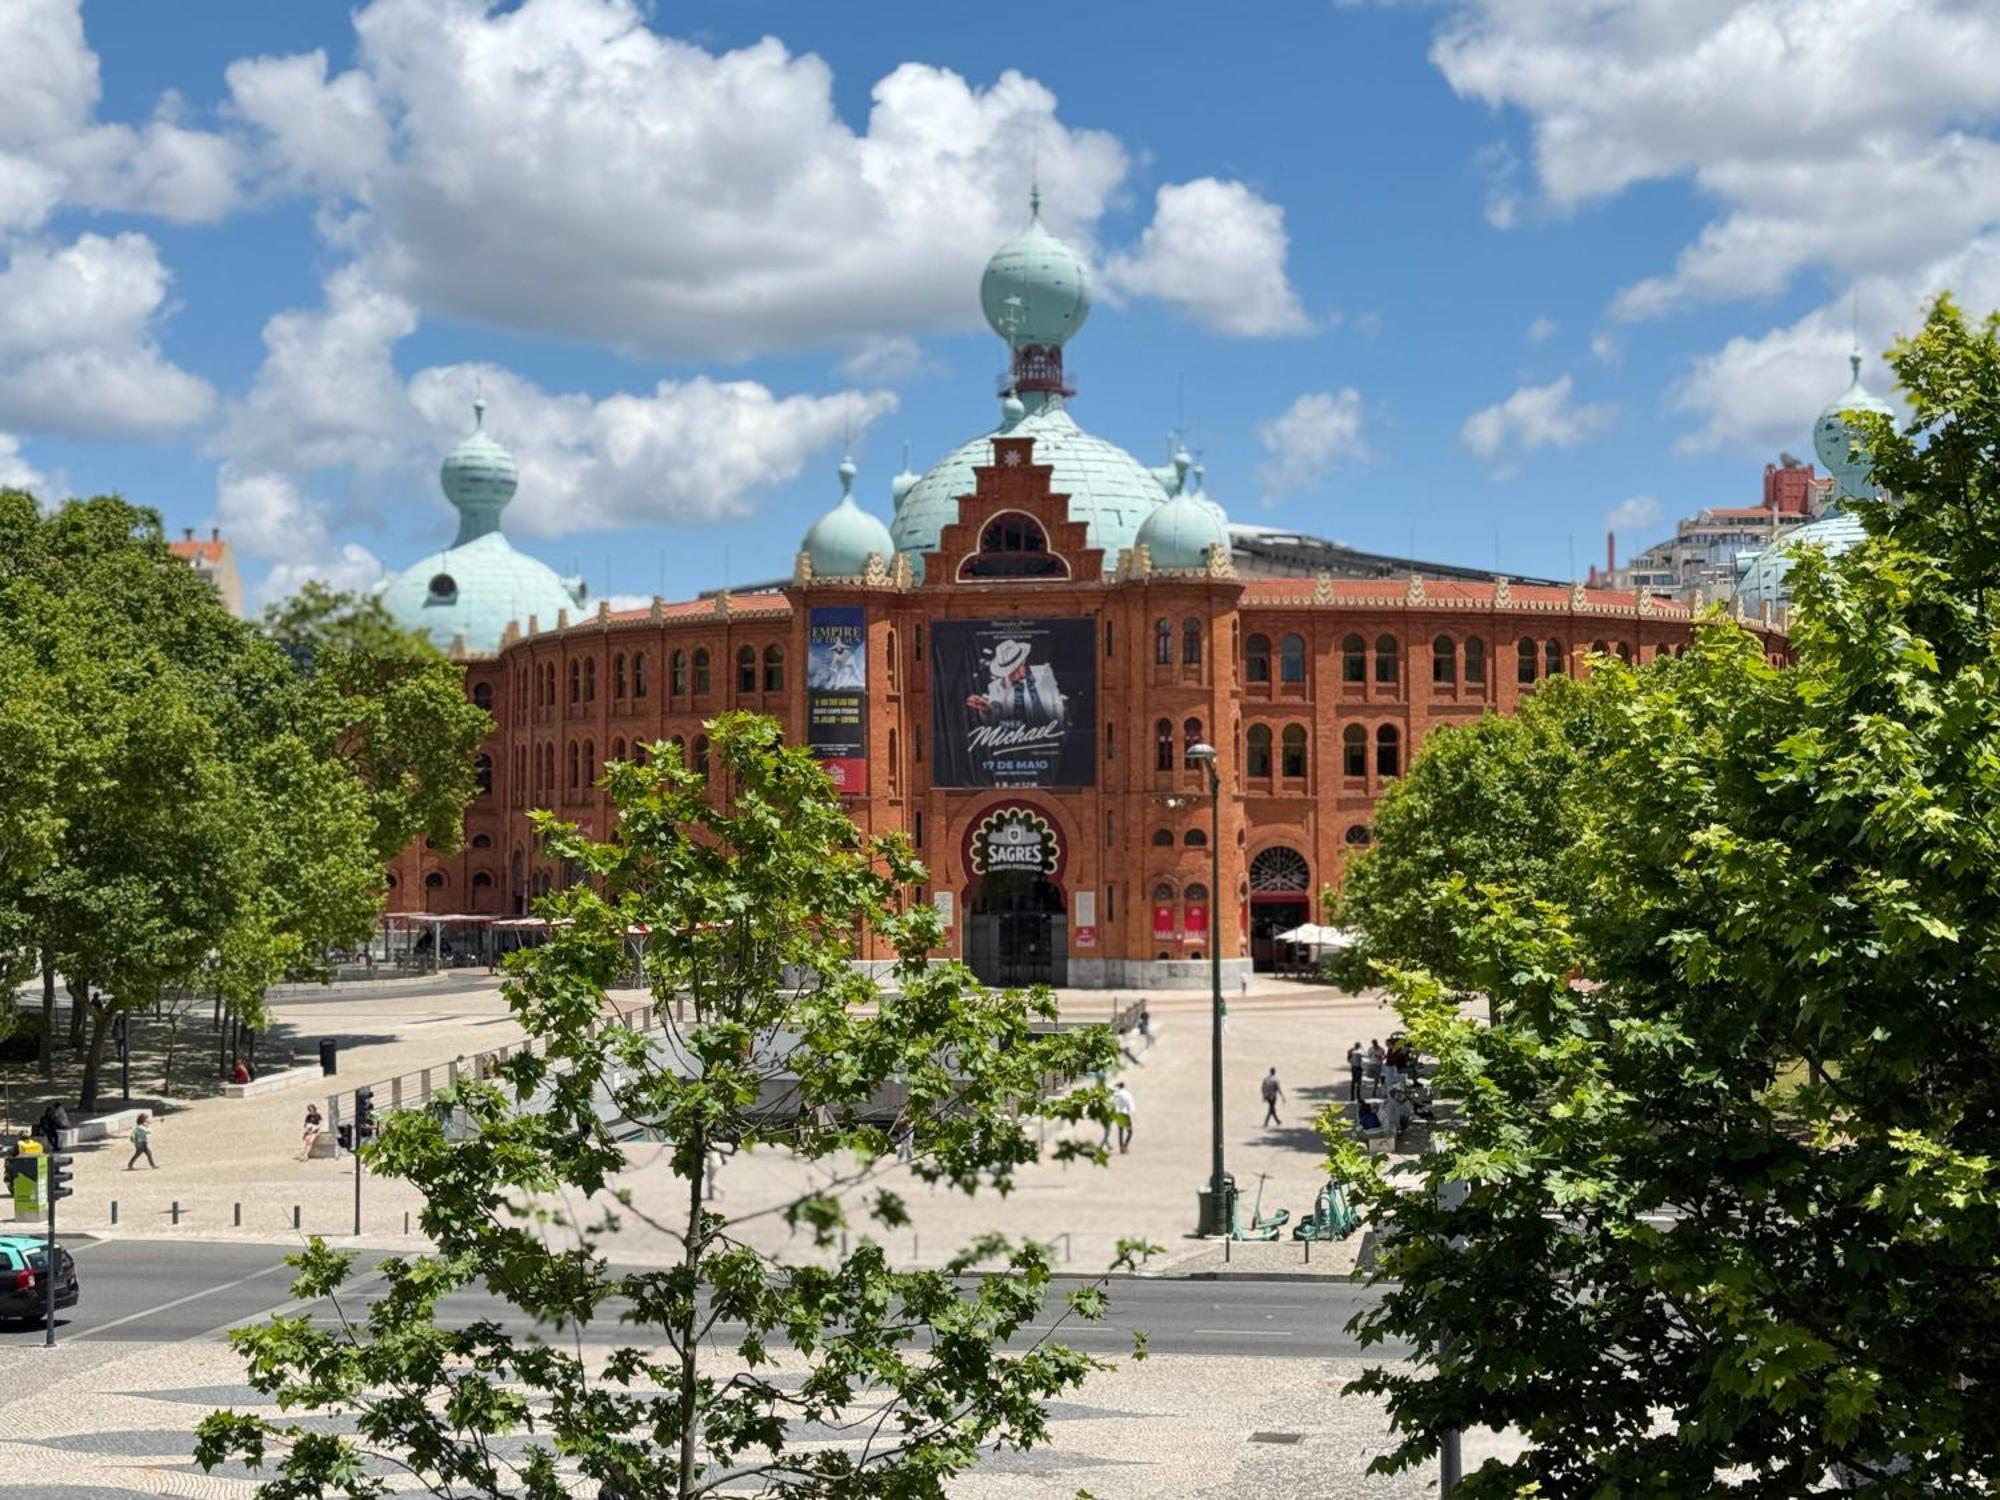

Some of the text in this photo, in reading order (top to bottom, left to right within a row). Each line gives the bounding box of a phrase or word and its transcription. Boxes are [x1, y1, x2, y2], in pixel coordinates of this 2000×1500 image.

[812, 626, 861, 638] EMPIRE
[967, 719, 1065, 752] Michael
[982, 760, 1048, 770] 17 DE MAIO
[987, 845, 1042, 863] SAGRES
